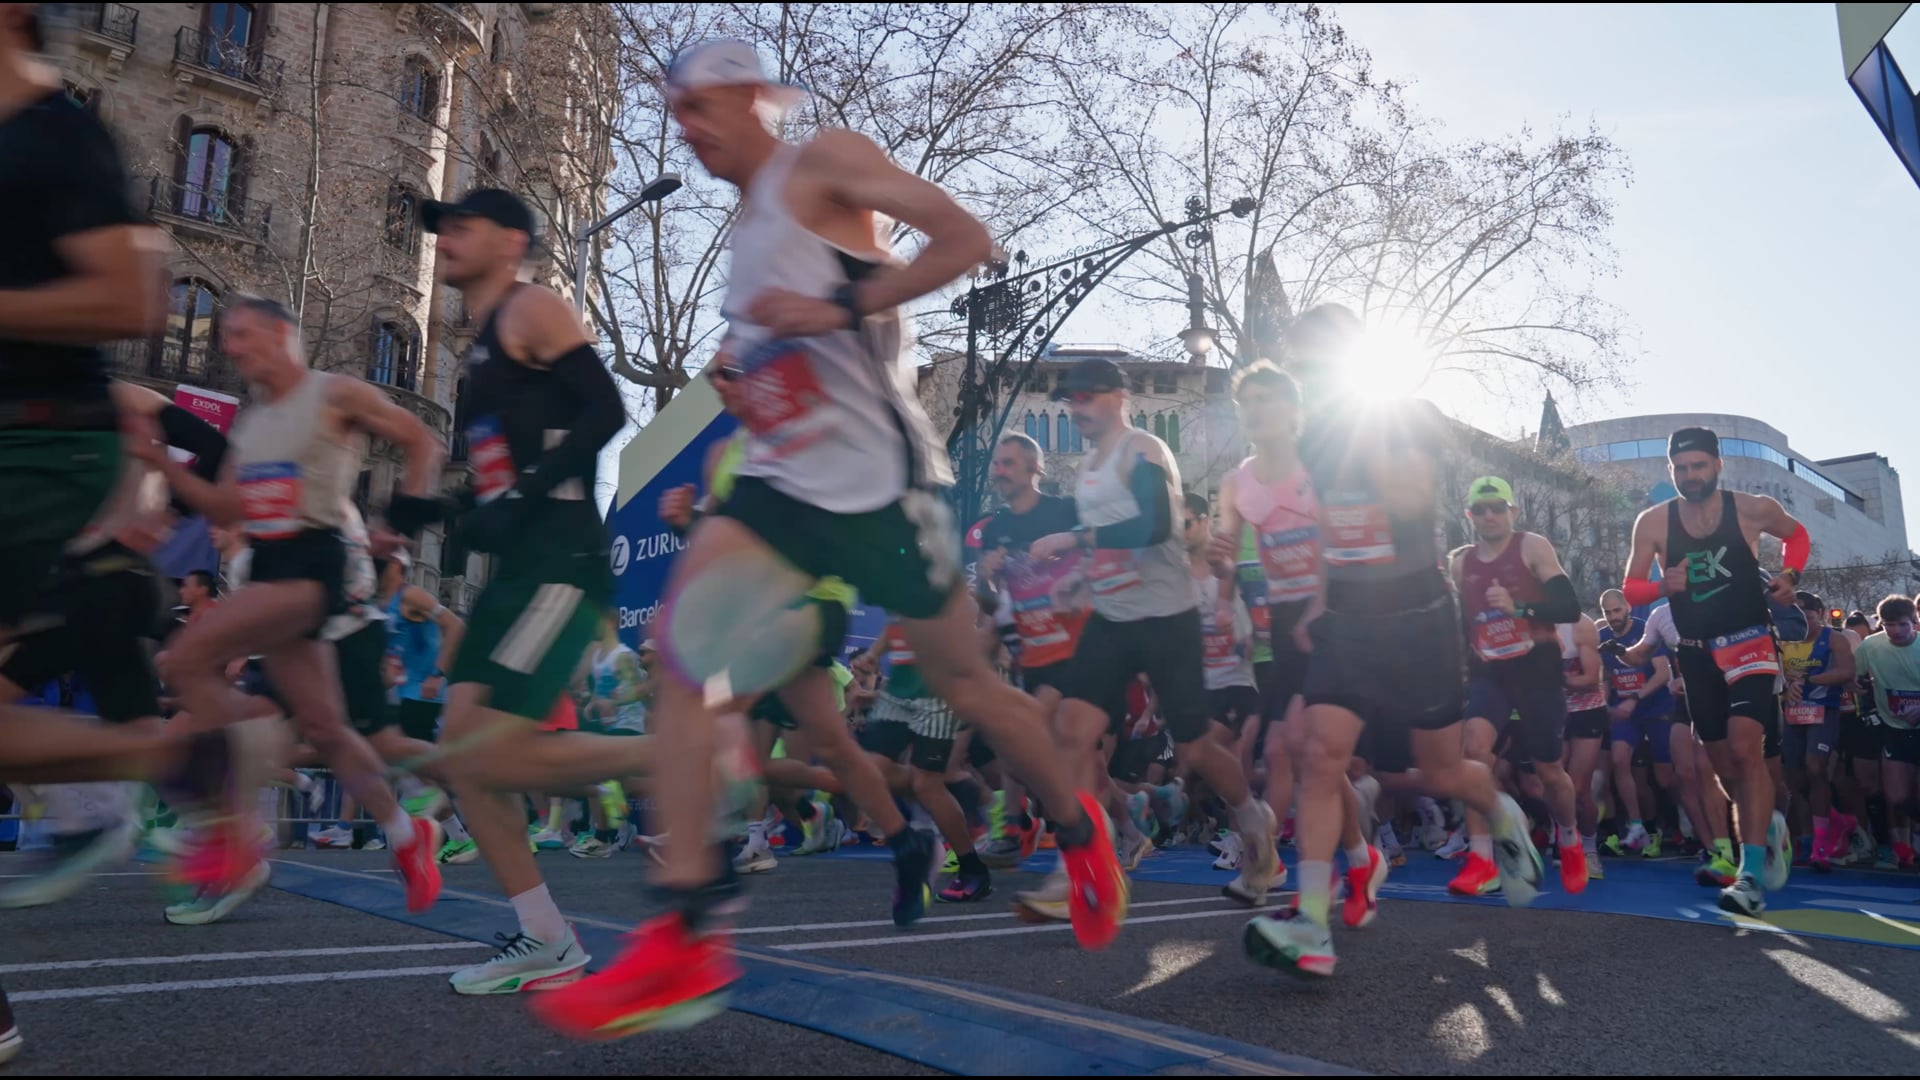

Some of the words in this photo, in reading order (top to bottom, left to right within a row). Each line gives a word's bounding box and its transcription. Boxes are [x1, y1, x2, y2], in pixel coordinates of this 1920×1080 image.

[636, 532, 690, 561] ZURIC
[1686, 546, 1732, 583] EK
[1730, 628, 1759, 643] ZURICH
